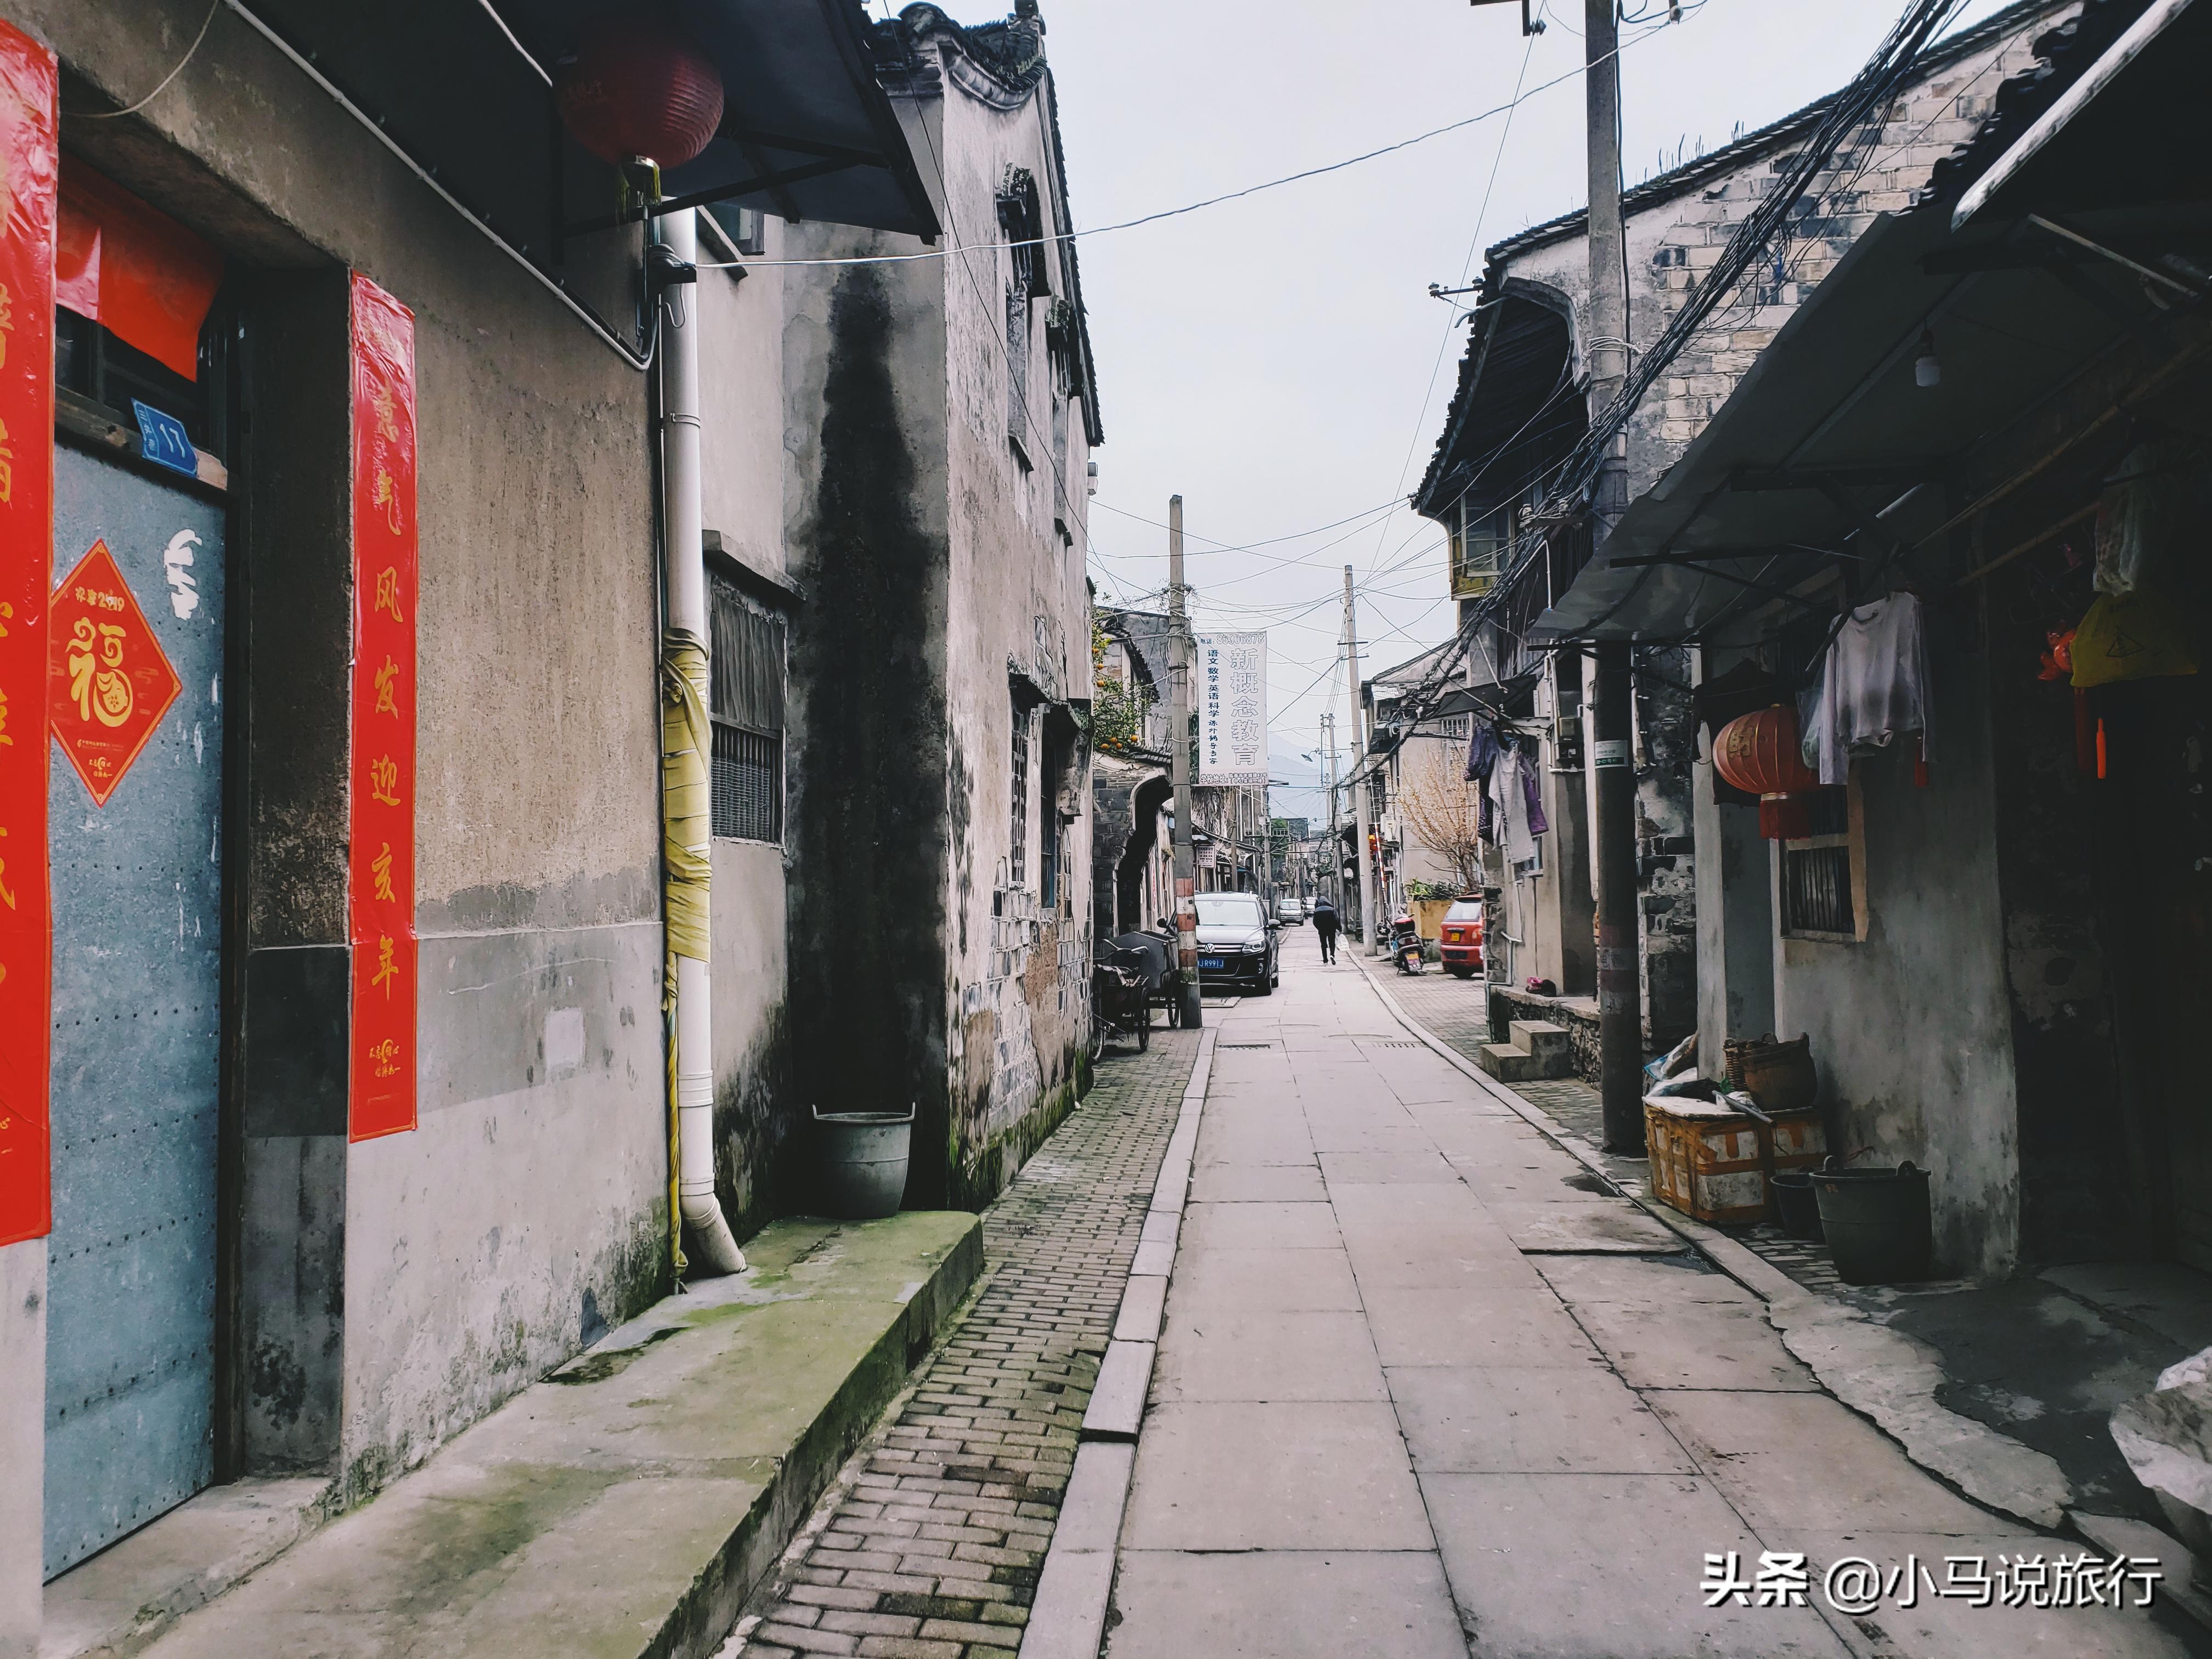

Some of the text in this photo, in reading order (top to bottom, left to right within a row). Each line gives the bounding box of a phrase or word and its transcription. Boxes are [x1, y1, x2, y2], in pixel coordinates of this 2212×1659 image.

[160, 424, 185, 458] 11
[66, 617, 133, 727] 福
[1231, 648, 1259, 765] 新概念教育
